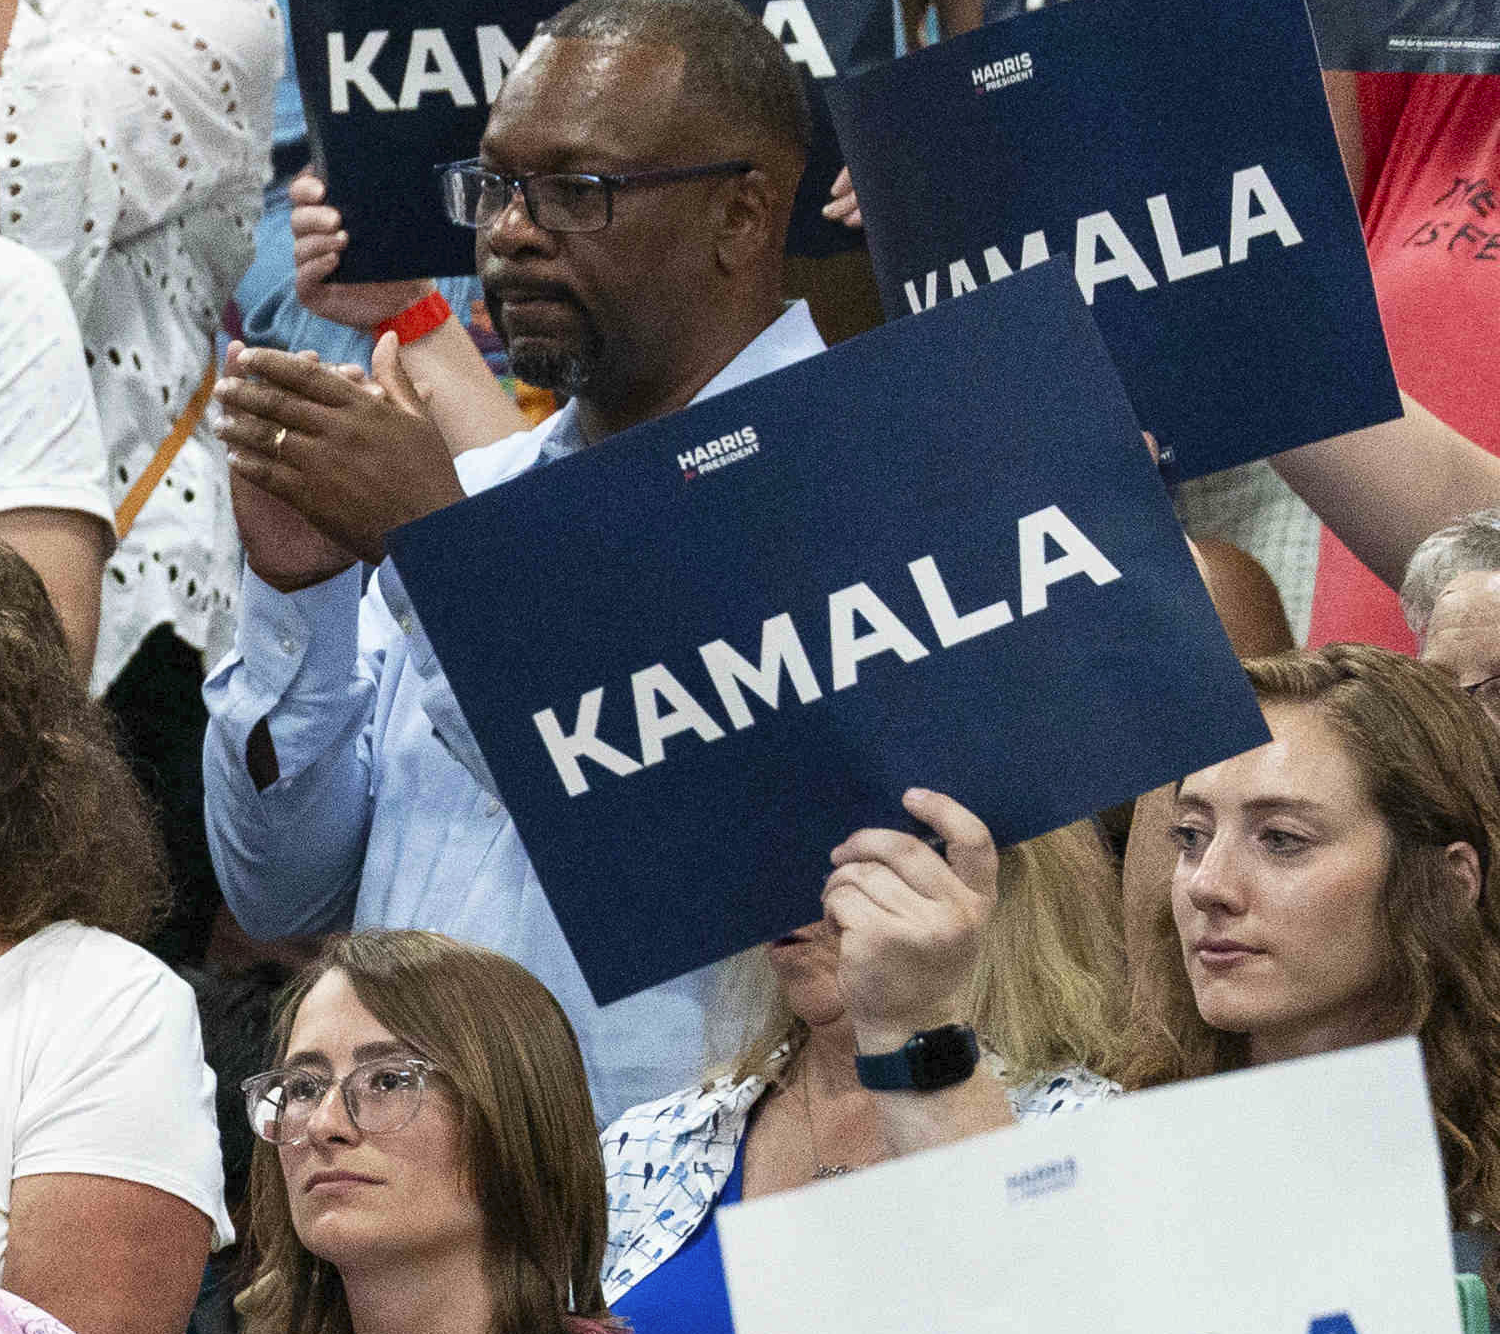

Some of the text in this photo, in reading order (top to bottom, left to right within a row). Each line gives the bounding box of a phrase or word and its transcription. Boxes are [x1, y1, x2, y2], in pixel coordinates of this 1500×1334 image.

[971, 53, 1033, 85] HARRIS
[677, 426, 758, 470] HARRIS
[697, 442, 760, 475] PRESIDENT
[532, 504, 1123, 798] KAMALA
